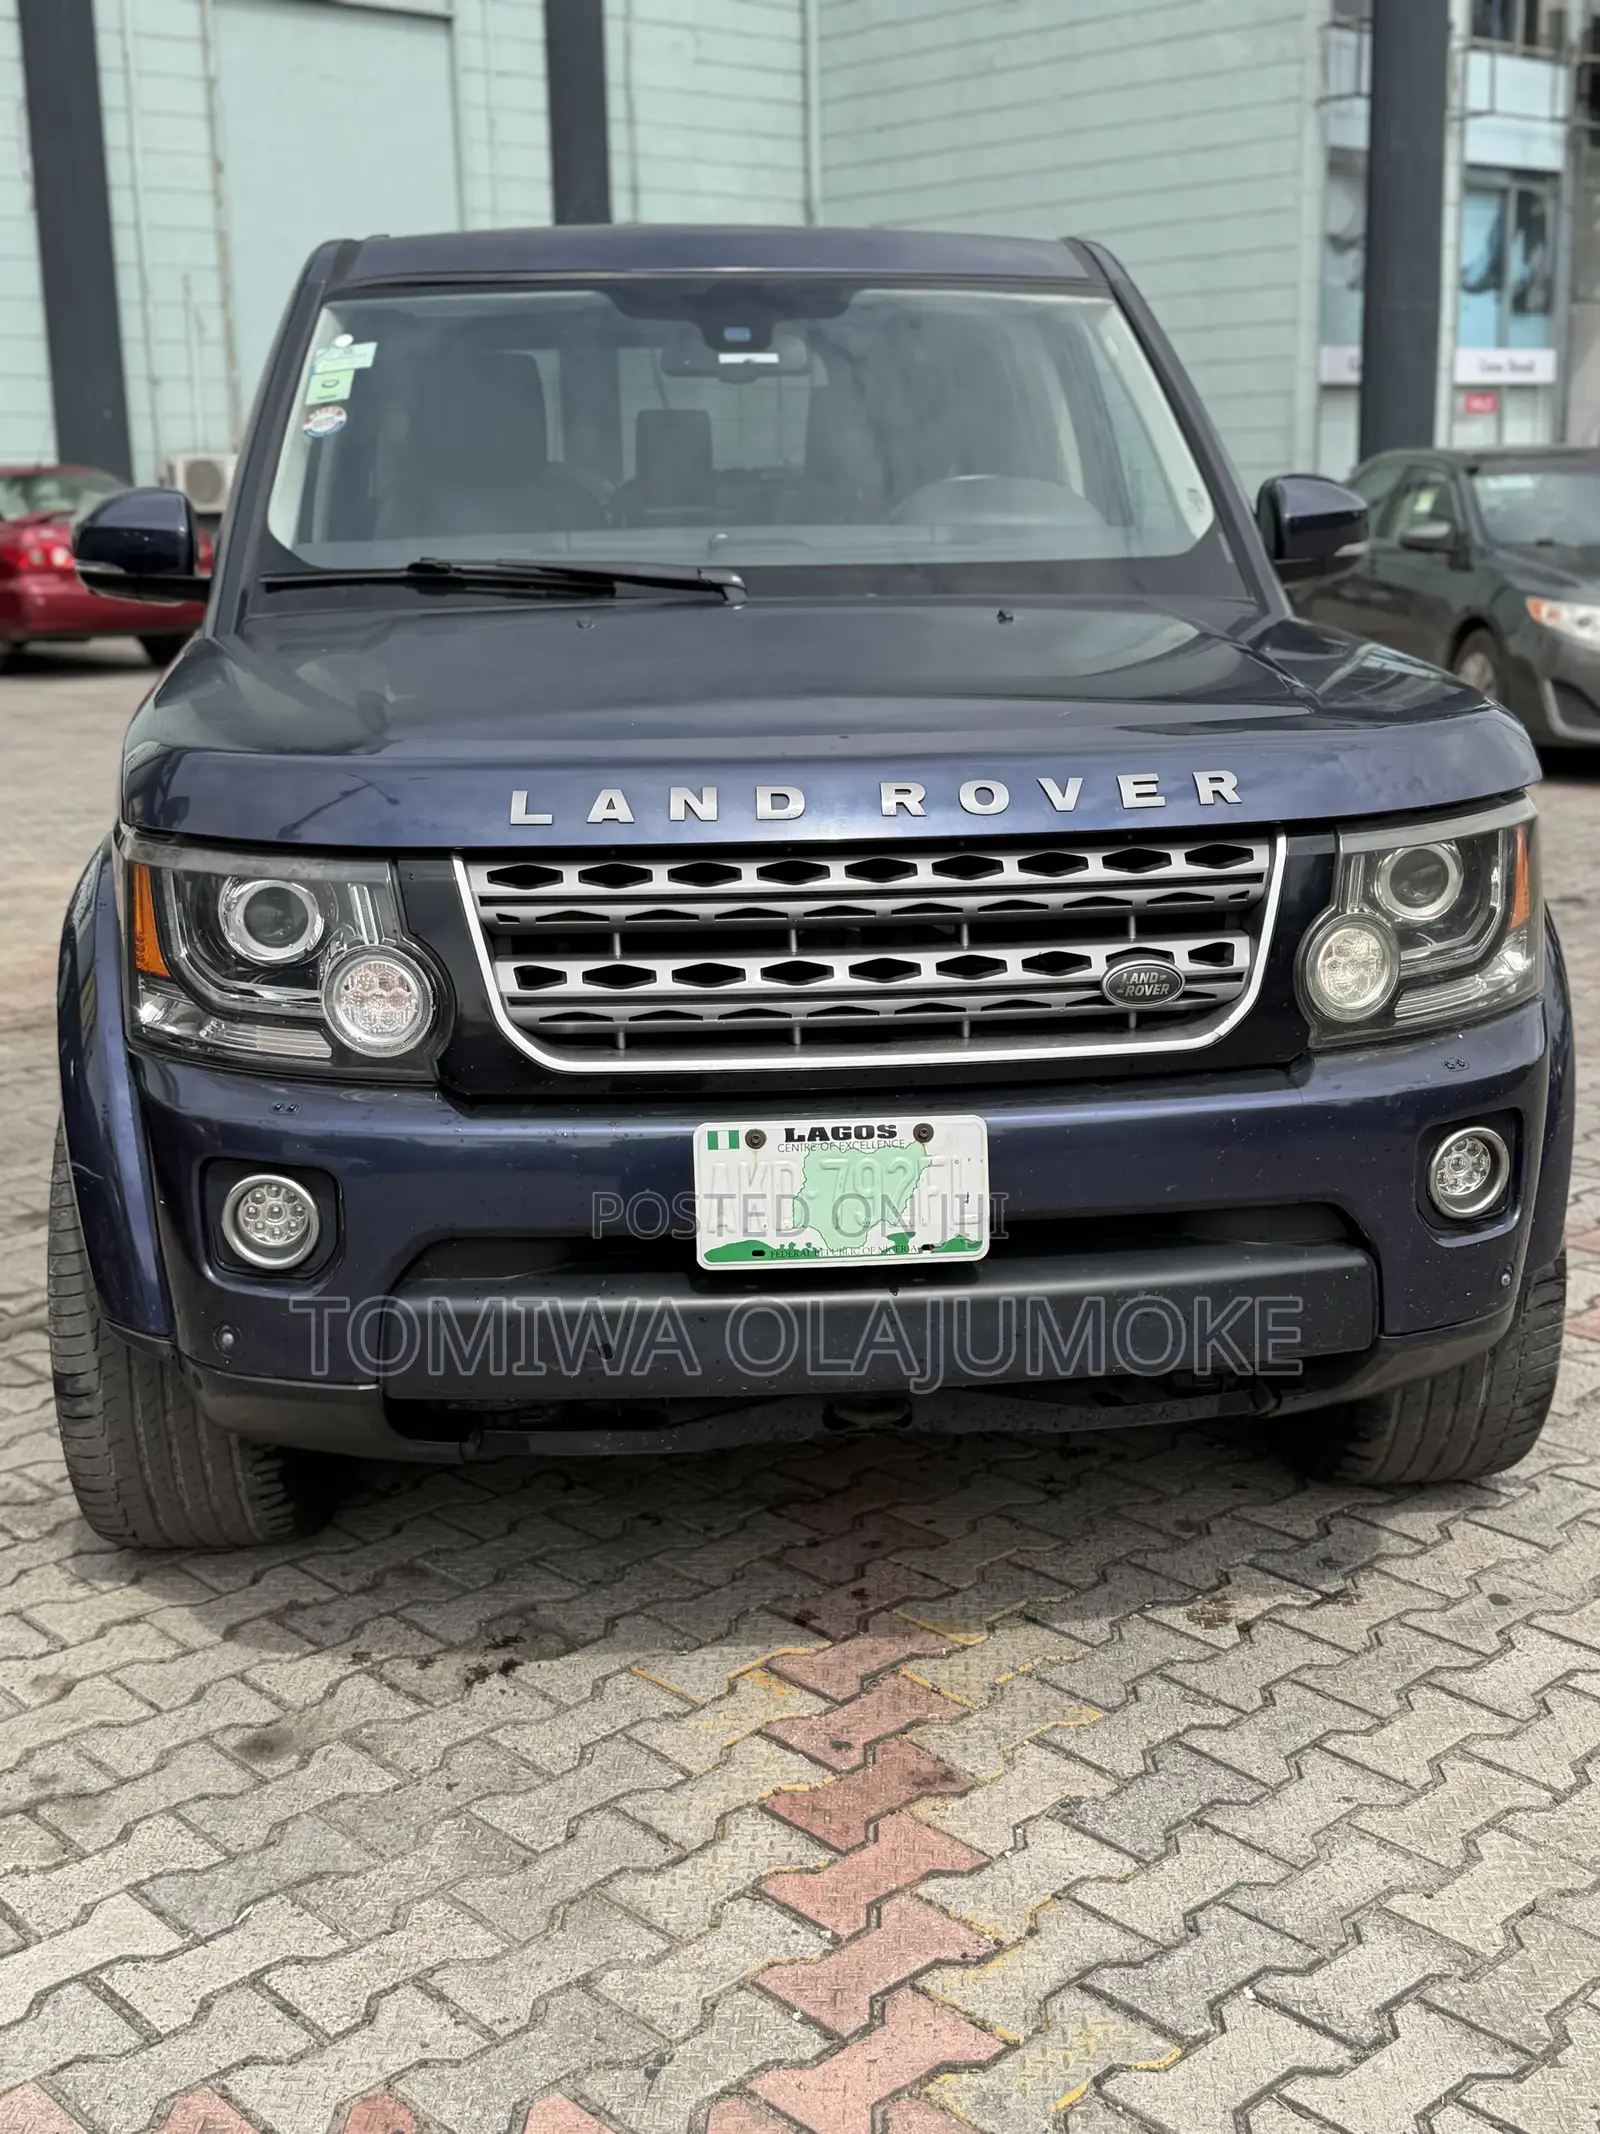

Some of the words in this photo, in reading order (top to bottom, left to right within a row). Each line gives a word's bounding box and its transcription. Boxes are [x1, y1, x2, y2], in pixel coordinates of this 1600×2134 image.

[510, 786, 805, 825] LAND
[880, 770, 1242, 817] ROVER
[1122, 972, 1158, 984] LAND
[1124, 983, 1170, 996] ROVER
[784, 1124, 898, 1143] LAGOS
[777, 1143, 816, 1153] CENTRE
[820, 1141, 836, 1151] OF
[840, 1139, 905, 1150] EXCELLENCE
[771, 1249, 813, 1259] FEDERAL
[861, 1247, 876, 1256] OF
[877, 1245, 919, 1255] NIGERIA
